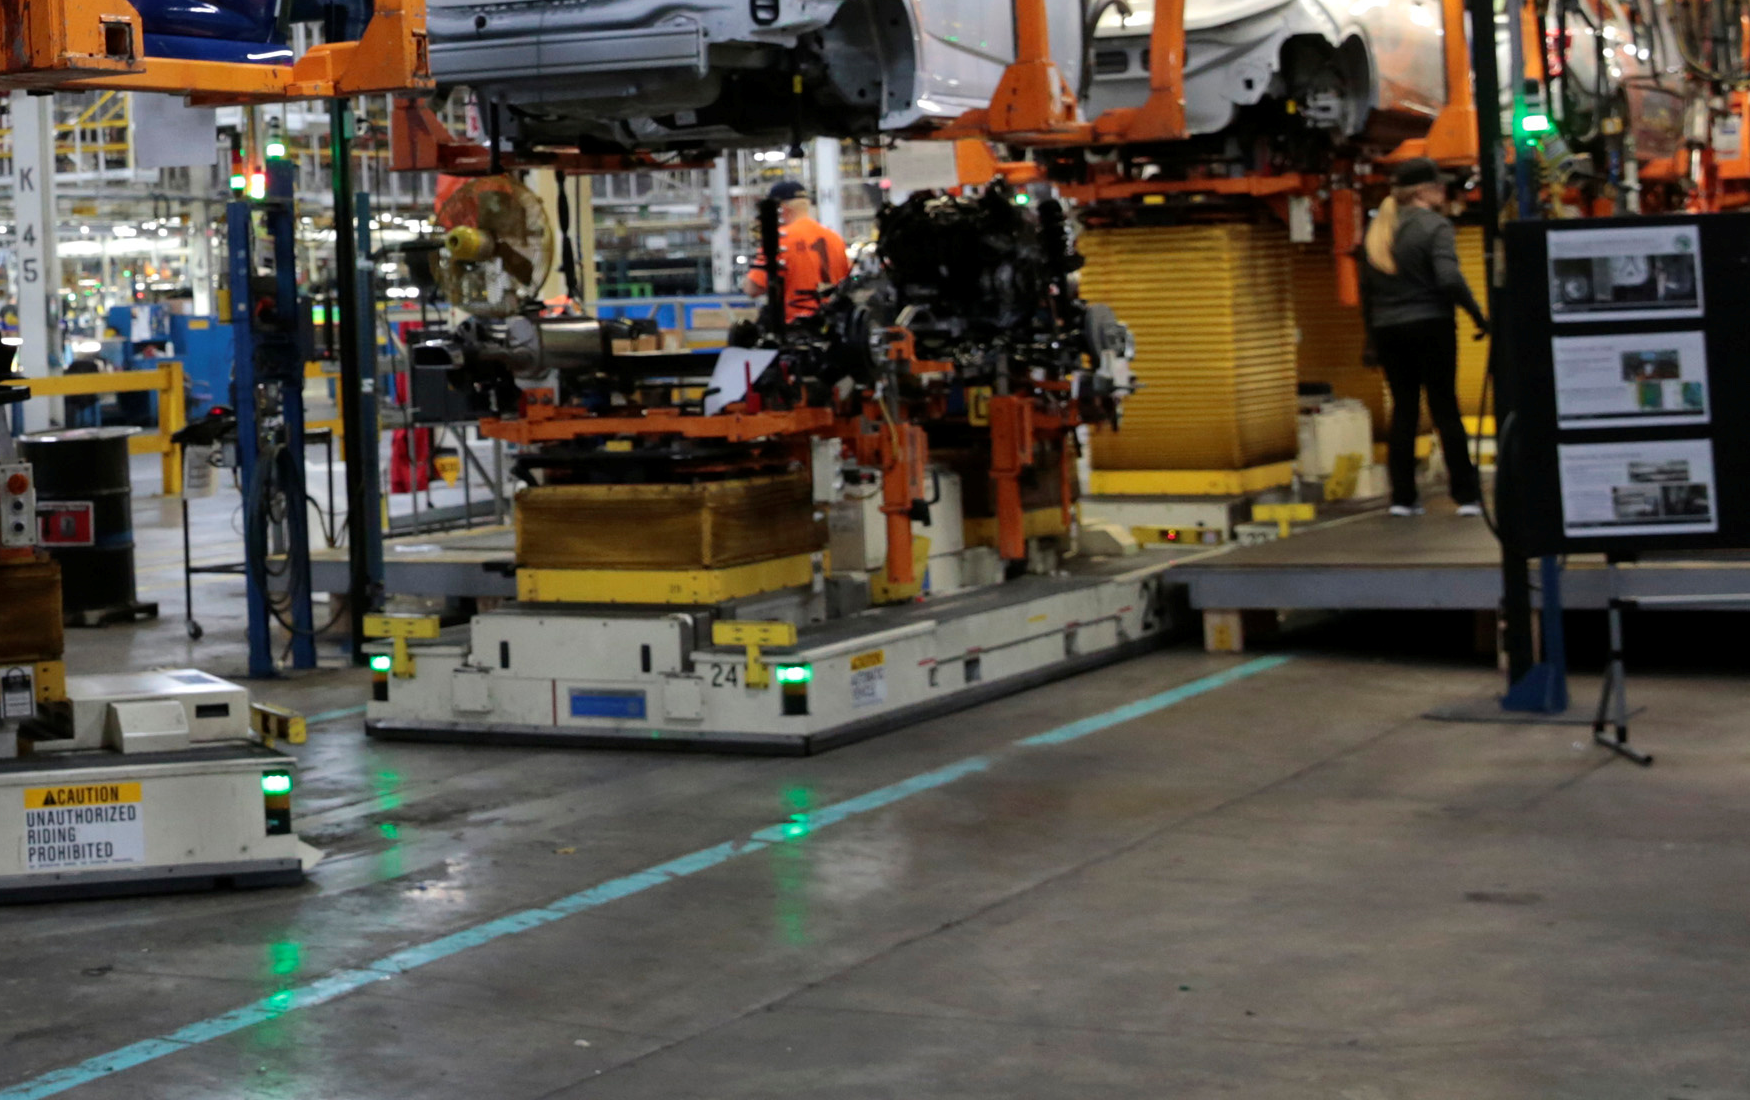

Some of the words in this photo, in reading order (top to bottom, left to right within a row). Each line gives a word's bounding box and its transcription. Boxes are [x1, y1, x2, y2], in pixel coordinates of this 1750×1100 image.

[19, 167, 34, 192] K
[710, 663, 738, 687] 24
[57, 786, 119, 805] CAUTION
[26, 805, 136, 828] UNAUTHORIZED
[27, 827, 76, 845] RIDING
[28, 842, 113, 862] PROHIBITED
